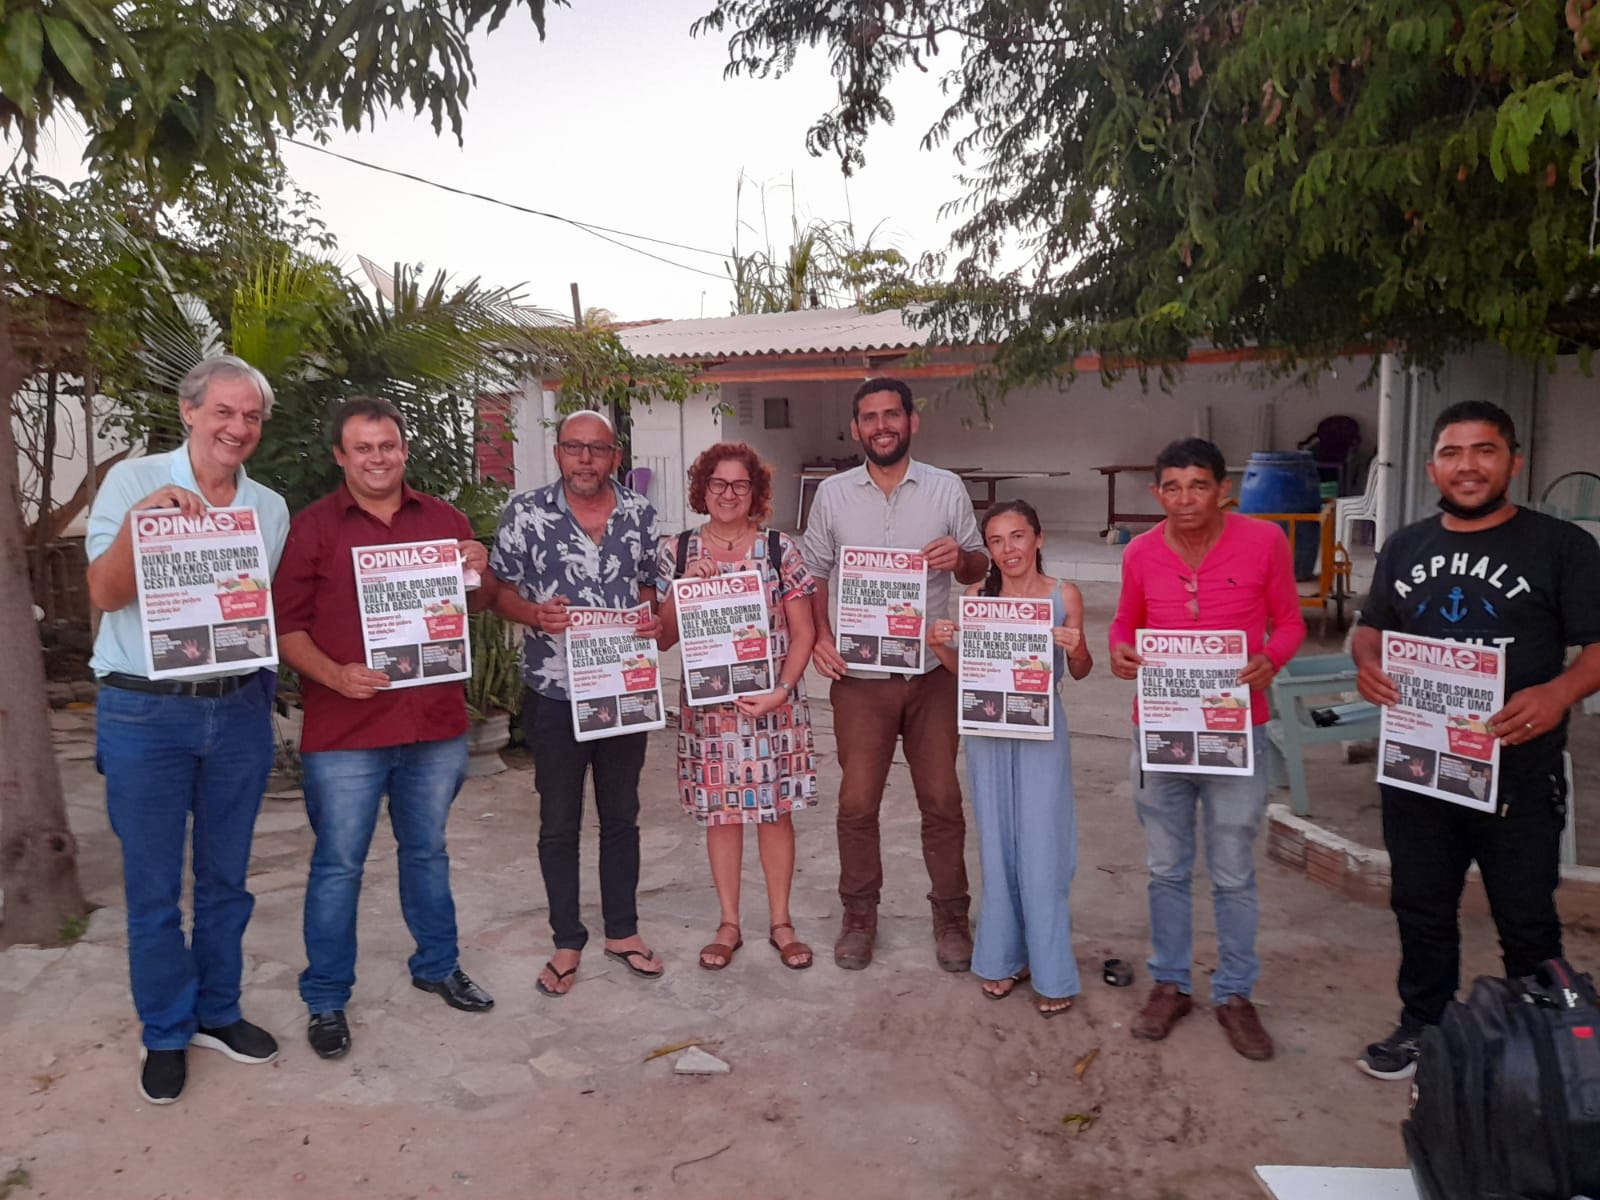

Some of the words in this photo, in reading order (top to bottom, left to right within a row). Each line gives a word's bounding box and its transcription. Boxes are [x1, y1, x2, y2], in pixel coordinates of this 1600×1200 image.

[183, 551, 196, 563] DE
[199, 546, 258, 561] BOLSONARO
[143, 565, 167, 577] VALE
[170, 562, 208, 575] MENOS
[211, 560, 230, 572] QUE
[234, 558, 259, 570] UMA
[1394, 553, 1531, 599] ASPHALT
[144, 577, 175, 589] CESTA
[396, 580, 406, 591] DE
[409, 576, 457, 589] BOLSONARO
[870, 580, 878, 588] DE
[880, 581, 920, 591] BOLSONARO
[363, 593, 383, 603] VALE
[386, 590, 416, 601] MENOS
[419, 589, 434, 598] QUE
[438, 586, 458, 596] UMA
[842, 587, 858, 595] VALE
[860, 588, 885, 597] MENOS
[887, 590, 900, 598] QUE
[903, 591, 919, 600] UMA
[842, 596, 861, 605] CESTA
[365, 603, 390, 614] CESTA
[709, 609, 718, 617] DE
[720, 604, 761, 616] BOLSONARO
[682, 620, 699, 629] VALE
[701, 617, 726, 627] MENOS
[728, 615, 741, 624] QUE
[744, 613, 761, 622] UMA
[684, 628, 705, 638] CESTA
[993, 632, 1002, 641] DE
[1005, 633, 1047, 643] BOLSONARO
[599, 638, 607, 646] DE
[609, 635, 650, 645] BOLSON
[963, 640, 980, 649] VALE
[983, 641, 1009, 650] MENOS
[1012, 643, 1026, 651] QUE
[1029, 644, 1046, 652] UMA
[572, 649, 589, 658] VALE
[590, 646, 616, 656] MENOS
[618, 644, 631, 653] QUE
[633, 642, 650, 651] UMA
[963, 650, 984, 658] CESTA
[573, 657, 594, 667] CESTA
[1177, 669, 1188, 678] DE
[1143, 679, 1163, 687] VALE
[1166, 679, 1197, 688] MENOS
[1200, 680, 1215, 688] QUE
[1143, 688, 1168, 697] CESTA
[1424, 679, 1434, 690] DE
[1437, 682, 1494, 702] BOLSONARO
[1412, 688, 1442, 703] MENOS
[1446, 696, 1464, 708] QUE
[1468, 700, 1492, 712] UMA
